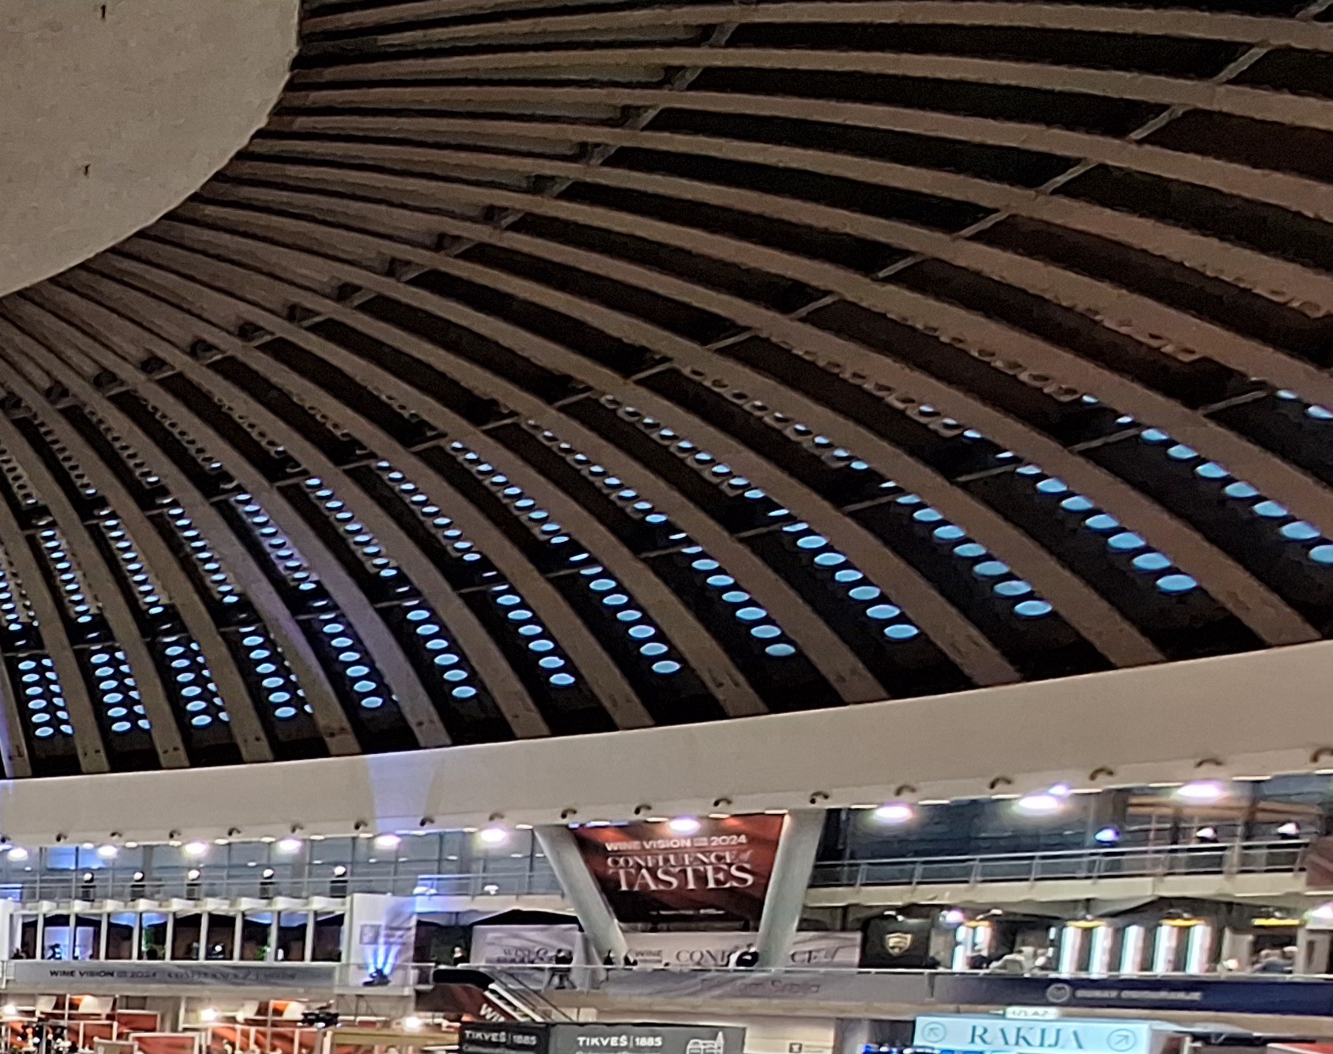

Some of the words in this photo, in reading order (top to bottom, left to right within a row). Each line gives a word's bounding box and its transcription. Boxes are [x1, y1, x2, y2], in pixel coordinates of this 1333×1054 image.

[605, 840, 641, 851] WINE
[643, 838, 691, 849] VISION
[710, 835, 747, 846] 2024
[607, 852, 732, 868] CONFLUENCE
[608, 863, 754, 891] TASTES
[464, 1030, 506, 1043] TIKVEŠ
[512, 1032, 537, 1045] 1885
[577, 1034, 628, 1047] TIKVEŠ
[635, 1036, 663, 1047] 1885
[968, 1024, 1084, 1050] RAKIJA
